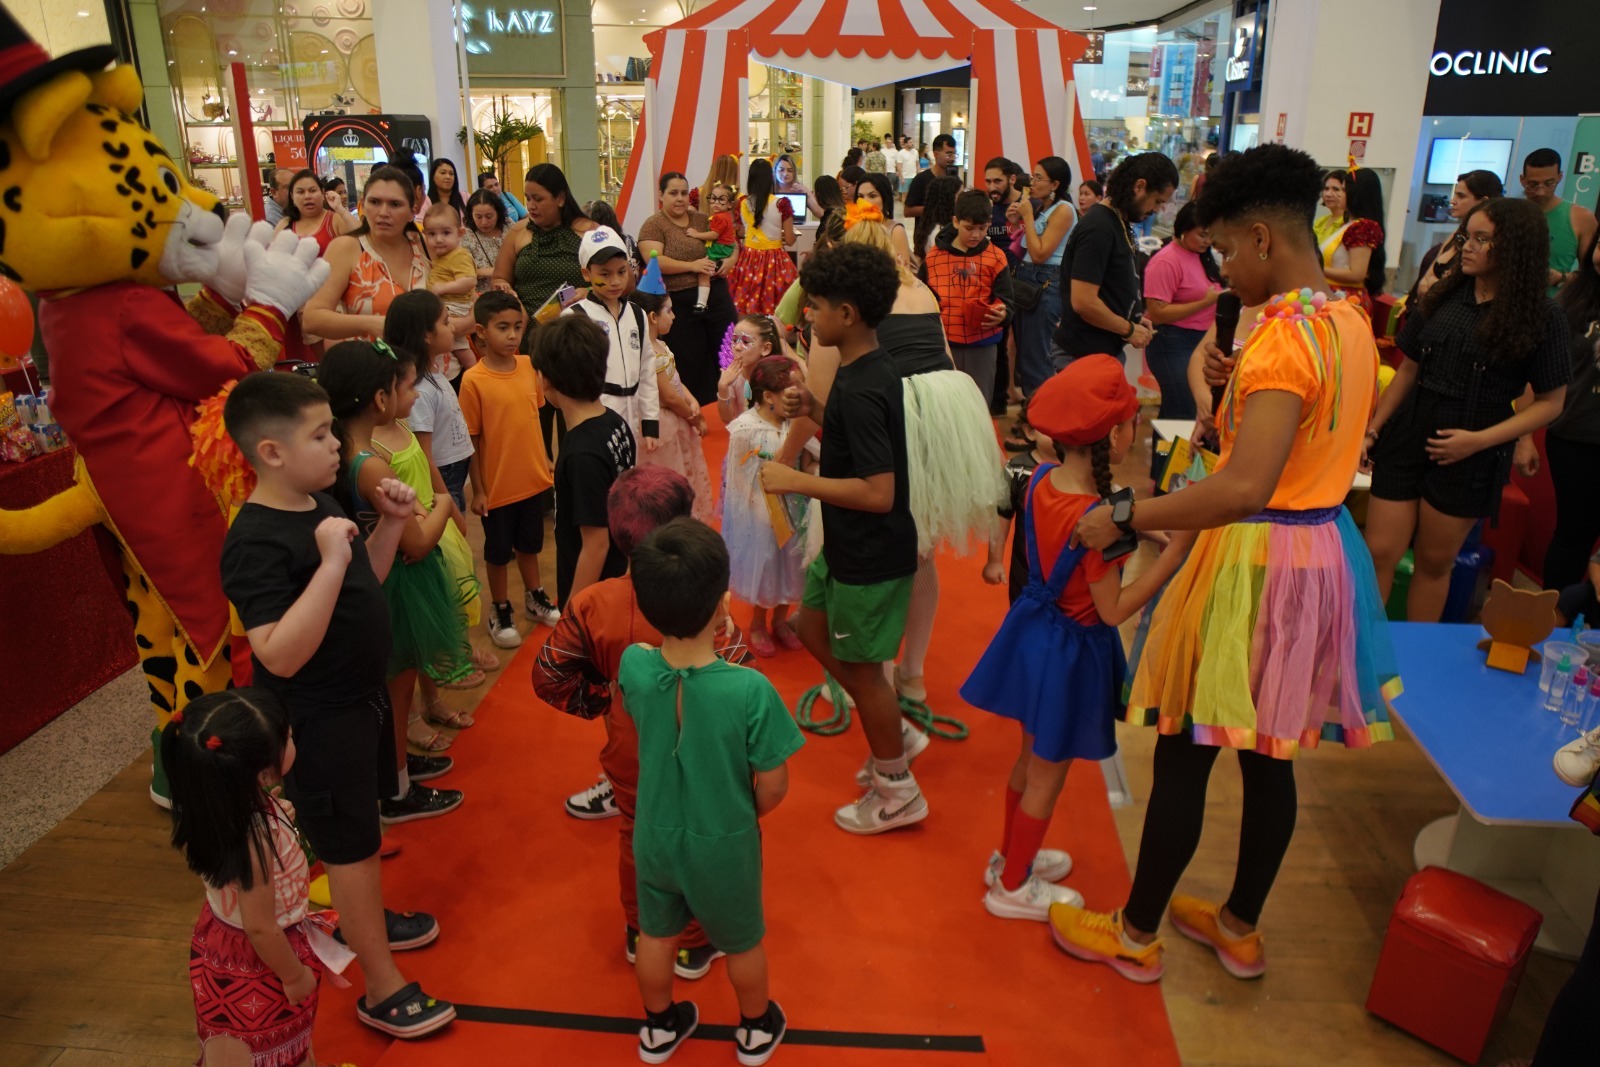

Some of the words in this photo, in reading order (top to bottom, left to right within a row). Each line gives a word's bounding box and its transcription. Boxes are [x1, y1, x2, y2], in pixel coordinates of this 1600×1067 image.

[487, 8, 555, 33] KAYZ
[1429, 47, 1552, 76] OCLINIC
[1351, 115, 1371, 134] H
[290, 147, 308, 160] 50
